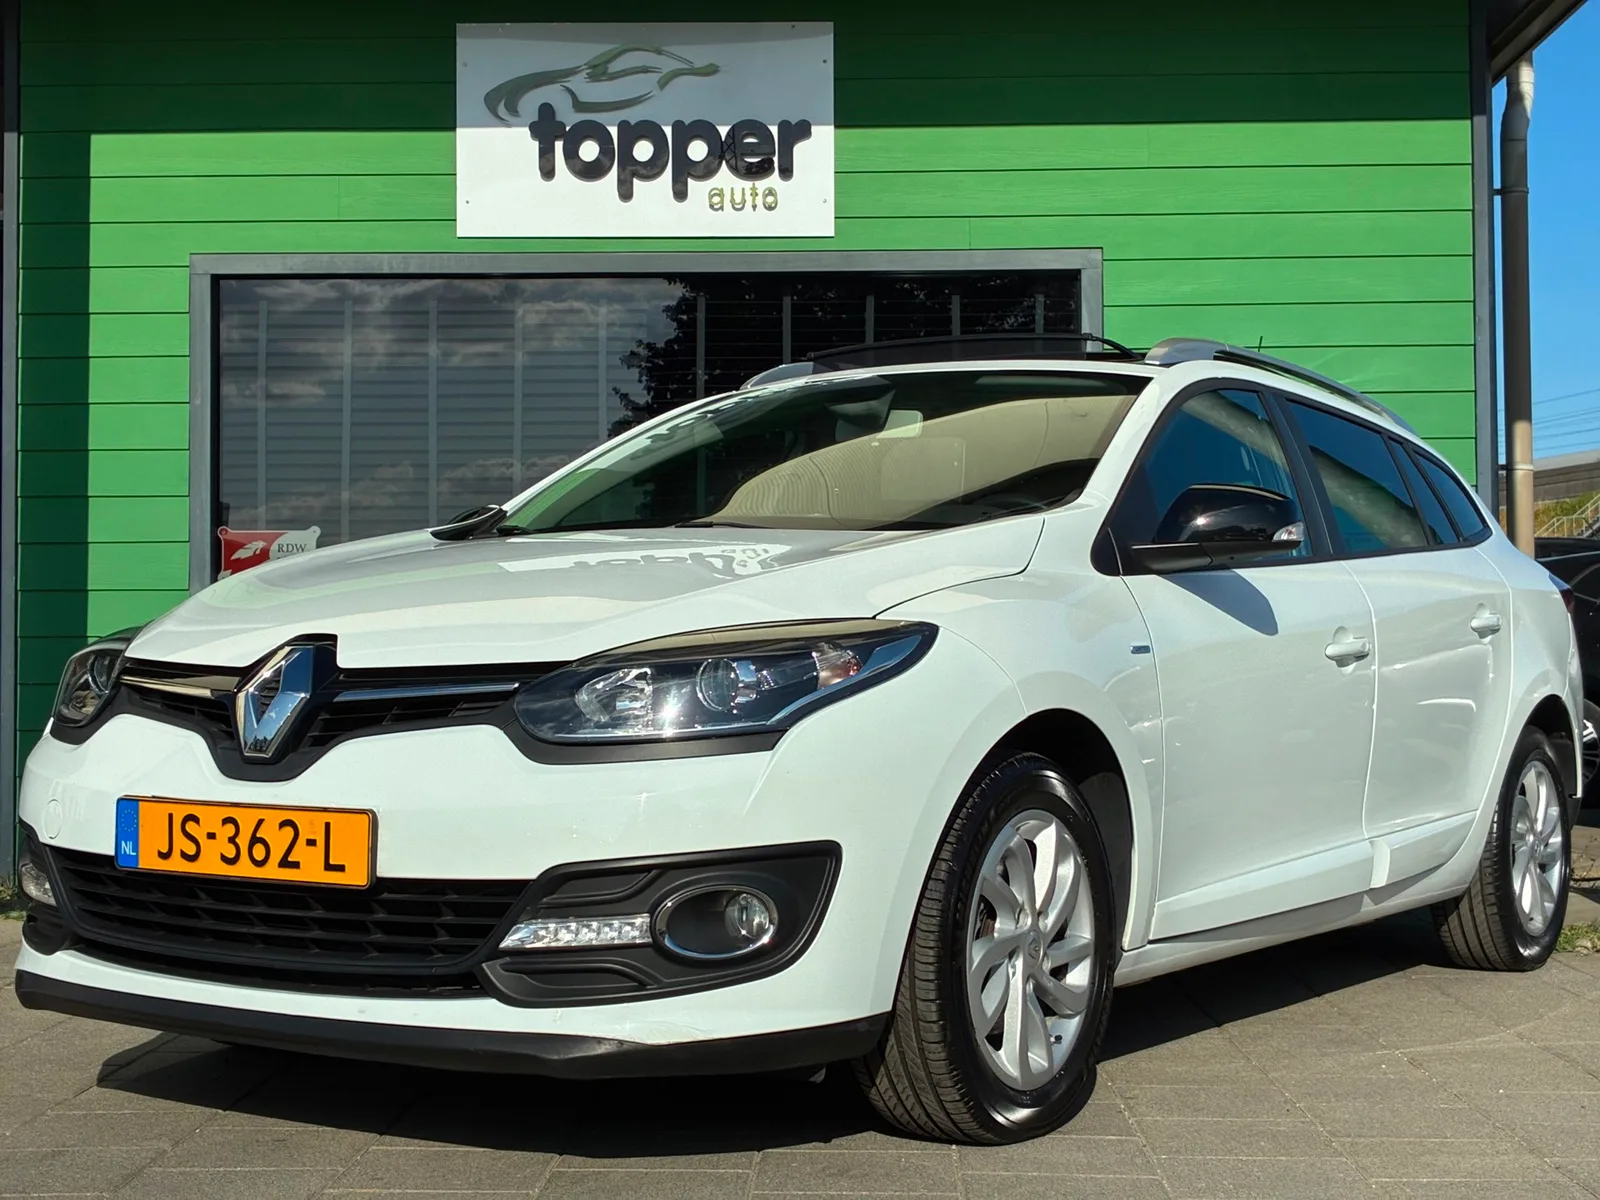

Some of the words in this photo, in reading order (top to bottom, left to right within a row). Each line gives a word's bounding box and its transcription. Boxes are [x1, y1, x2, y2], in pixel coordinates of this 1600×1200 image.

[528, 102, 812, 203] topper
[708, 183, 778, 212] auto
[277, 543, 307, 553] RDW
[121, 840, 137, 856] NL
[157, 812, 346, 873] JS-362-L
